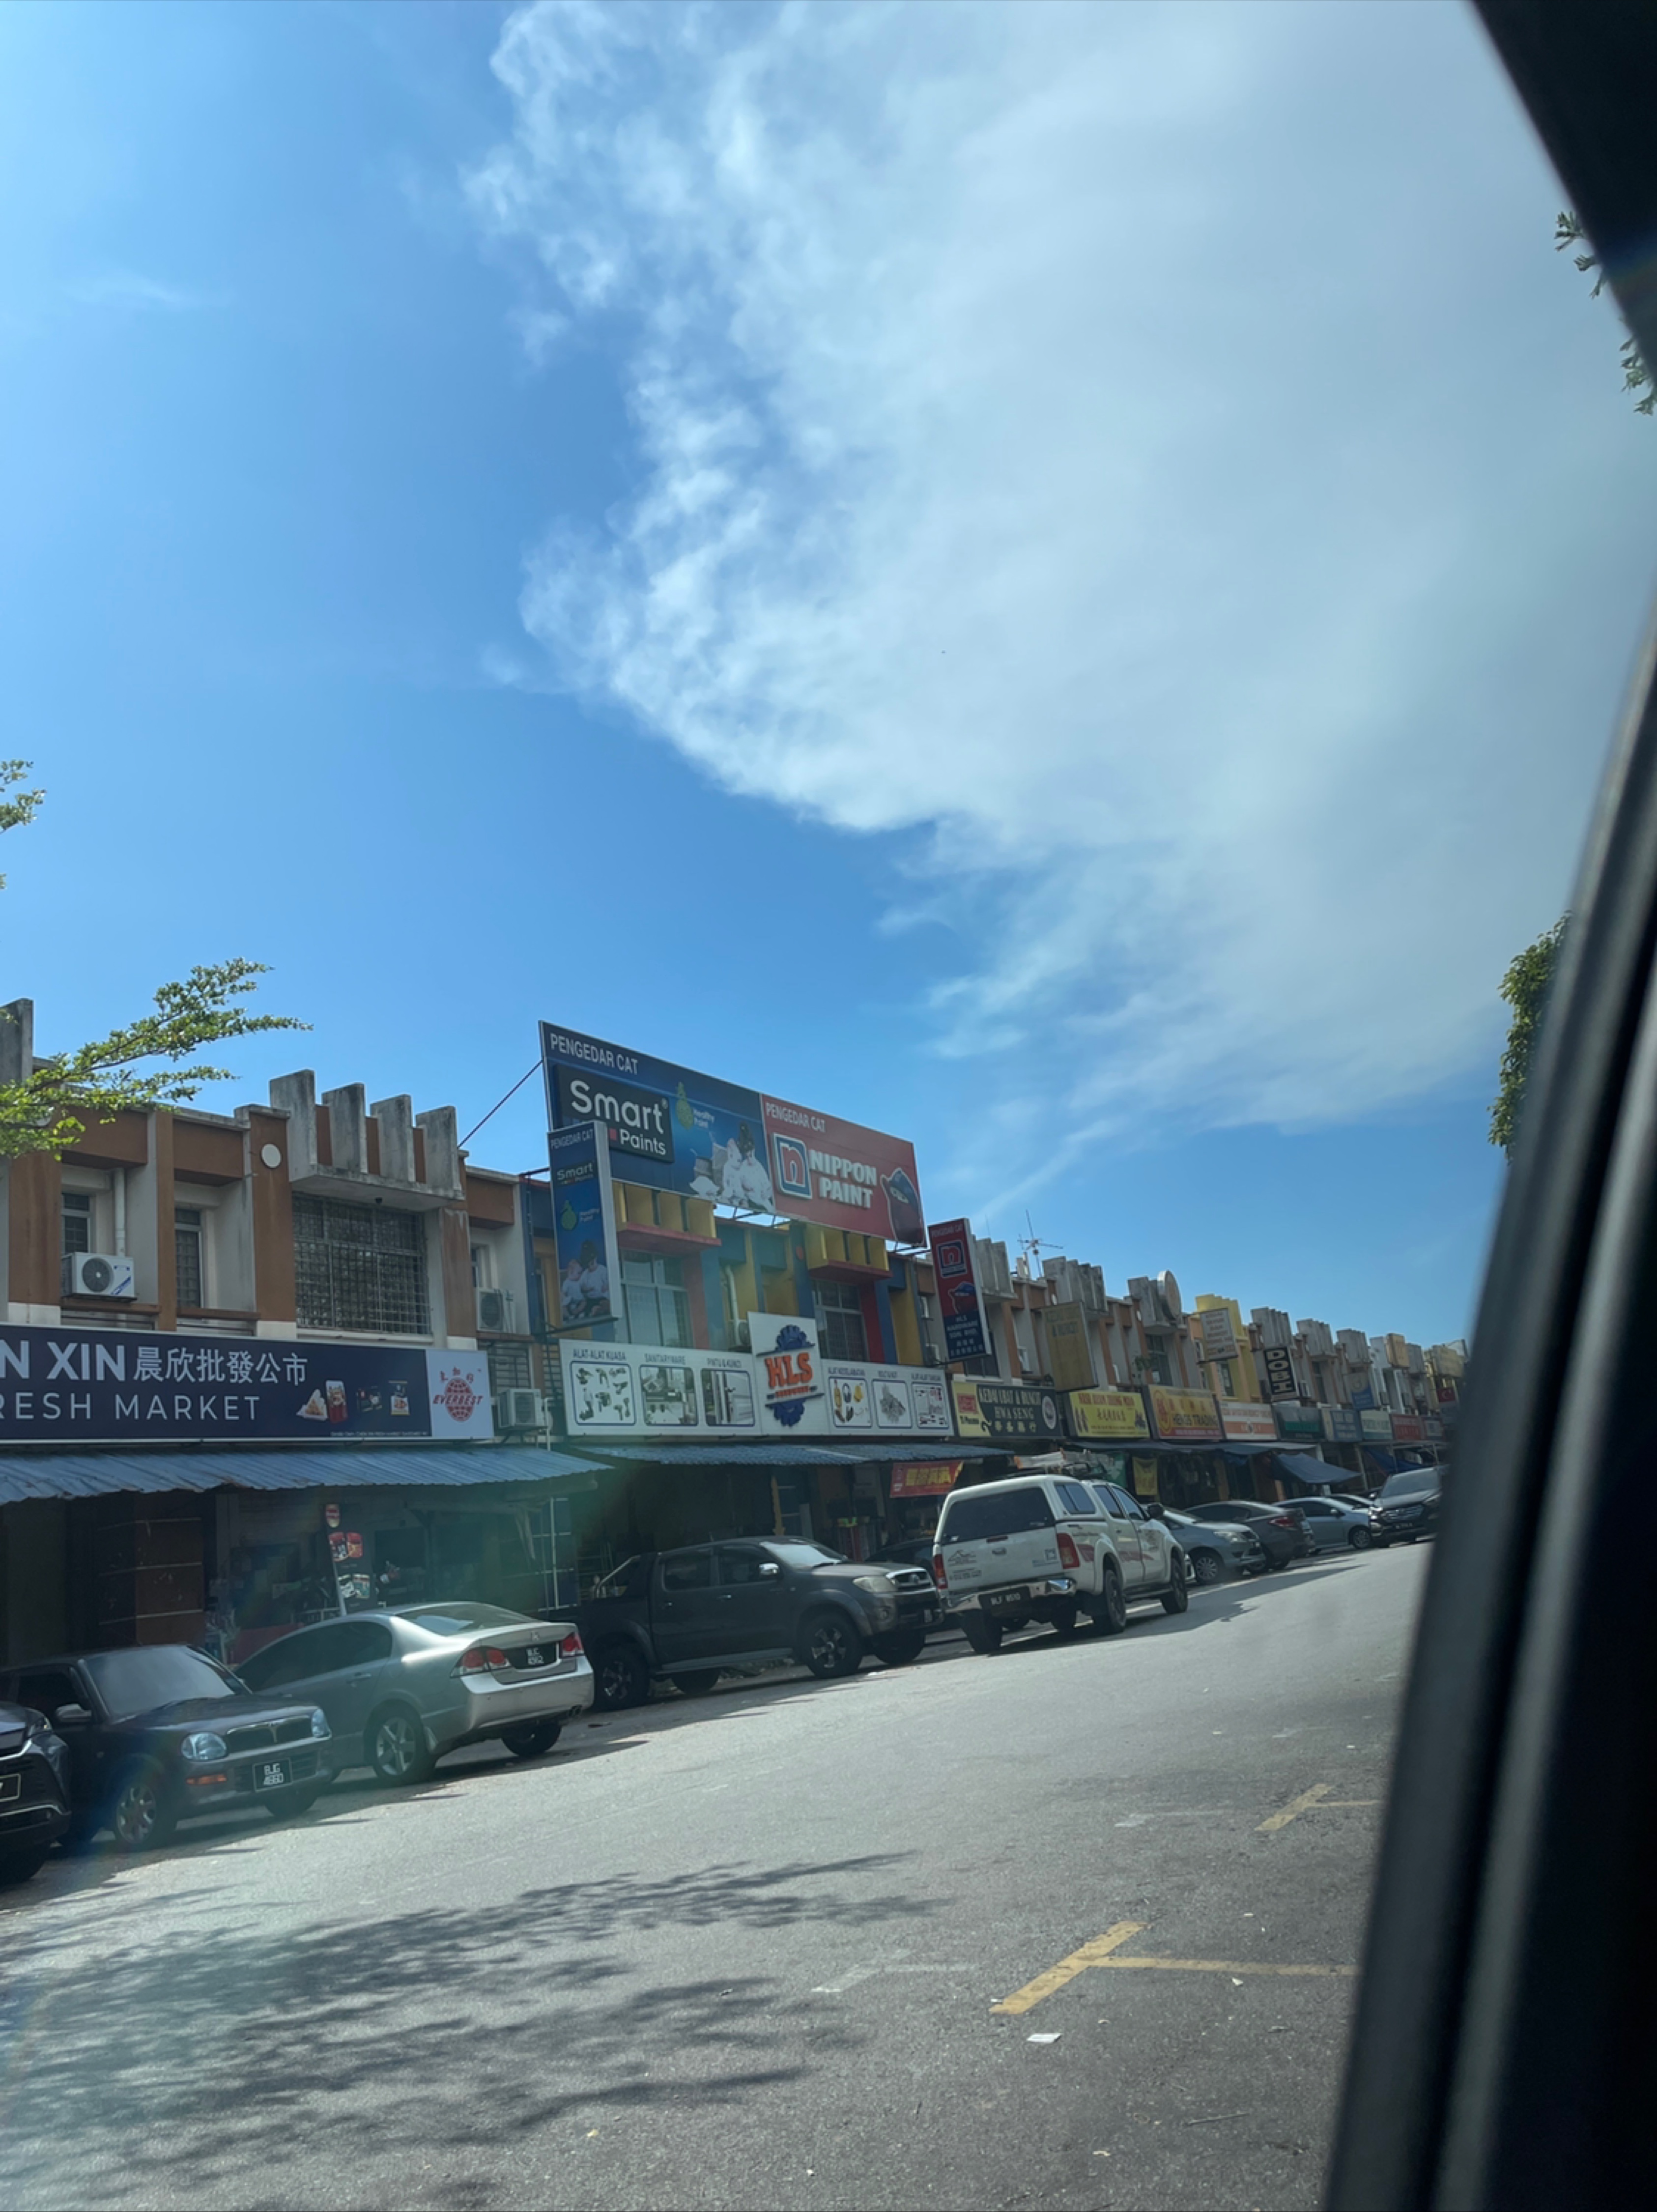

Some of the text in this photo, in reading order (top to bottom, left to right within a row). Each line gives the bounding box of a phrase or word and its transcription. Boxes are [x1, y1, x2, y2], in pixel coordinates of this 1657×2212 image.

[550, 1033, 638, 1075] PENGEDAR CAT
[570, 1080, 663, 1134] Smart
[766, 1102, 826, 1132] PENGEDAR CAT
[620, 1129, 666, 1155] Paints
[557, 1163, 593, 1180] Smart
[809, 1149, 877, 1185] NIPPON
[819, 1177, 872, 1208] PAINT
[47, 1342, 125, 1381] XIN
[134, 1346, 308, 1386] 晨欣批發公市
[764, 1352, 813, 1389] HLS
[0, 1393, 259, 1420] ESH MARKET
[433, 1394, 484, 1406] EVERBEST
